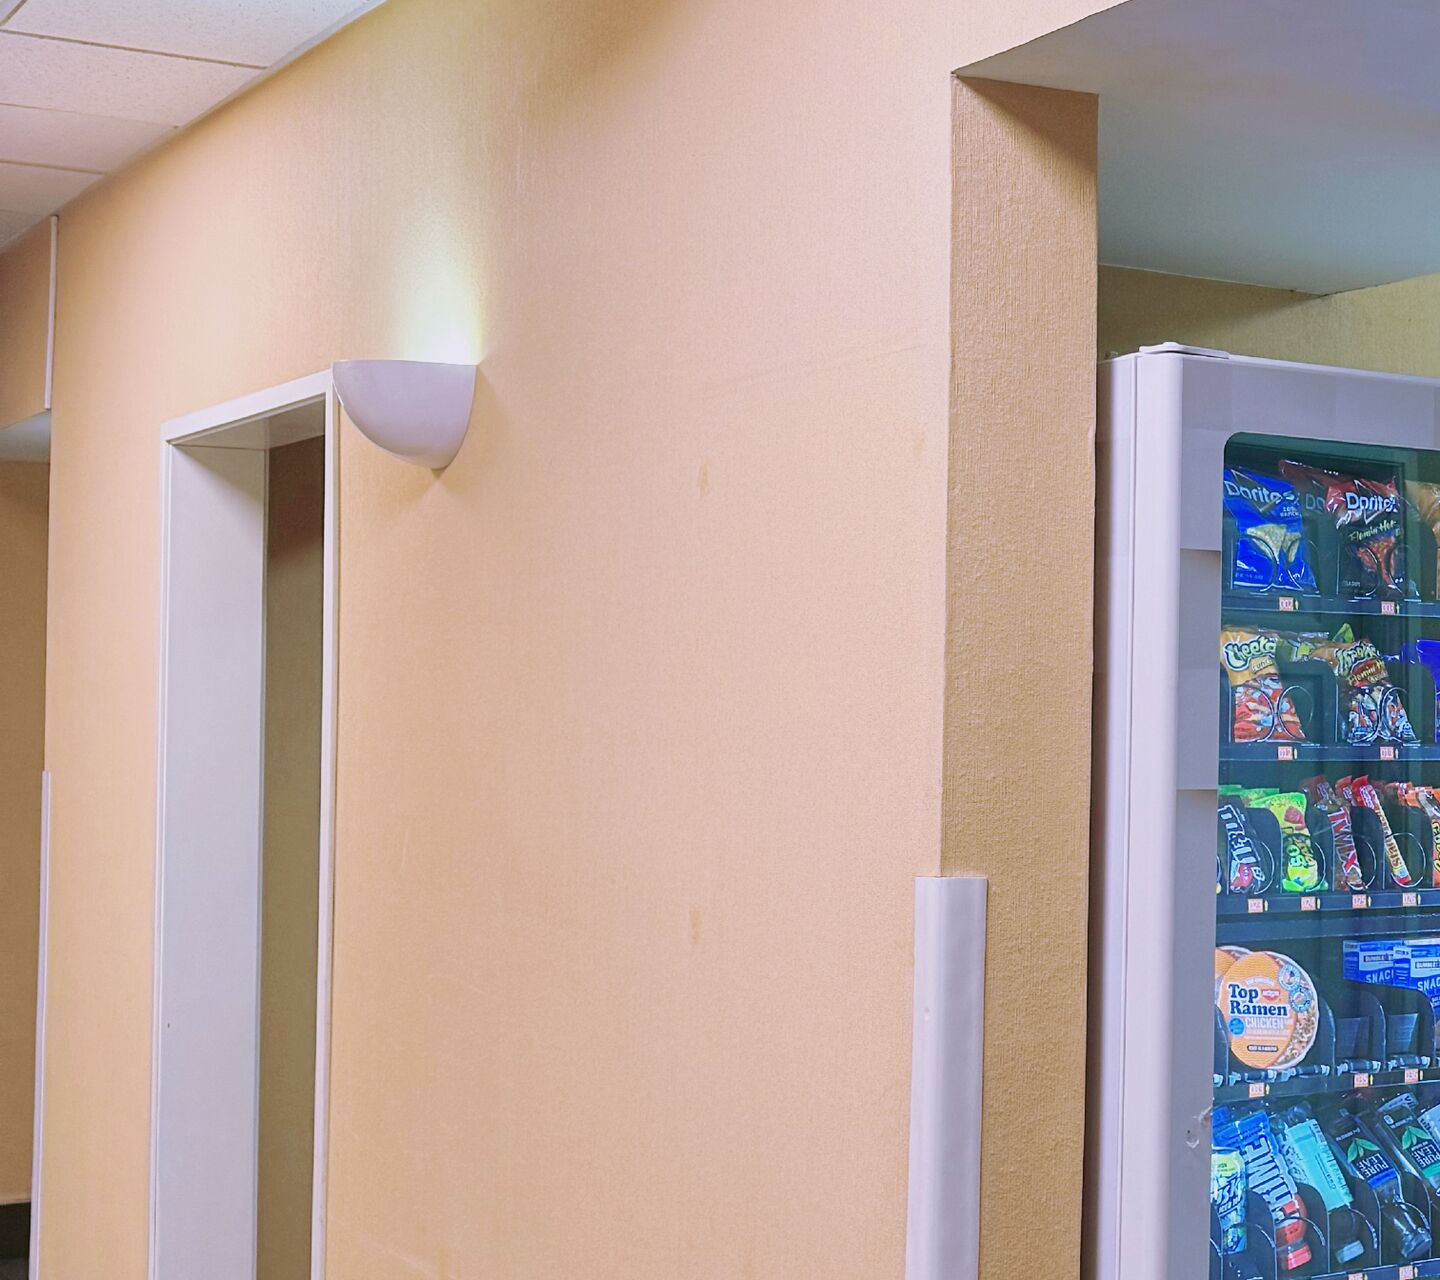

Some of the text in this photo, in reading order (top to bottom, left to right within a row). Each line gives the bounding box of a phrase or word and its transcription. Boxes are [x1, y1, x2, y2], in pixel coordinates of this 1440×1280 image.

[1228, 984, 1259, 1003] Top
[1229, 1000, 1288, 1017] Ramen
[1245, 1017, 1285, 1029] CHICKEN
